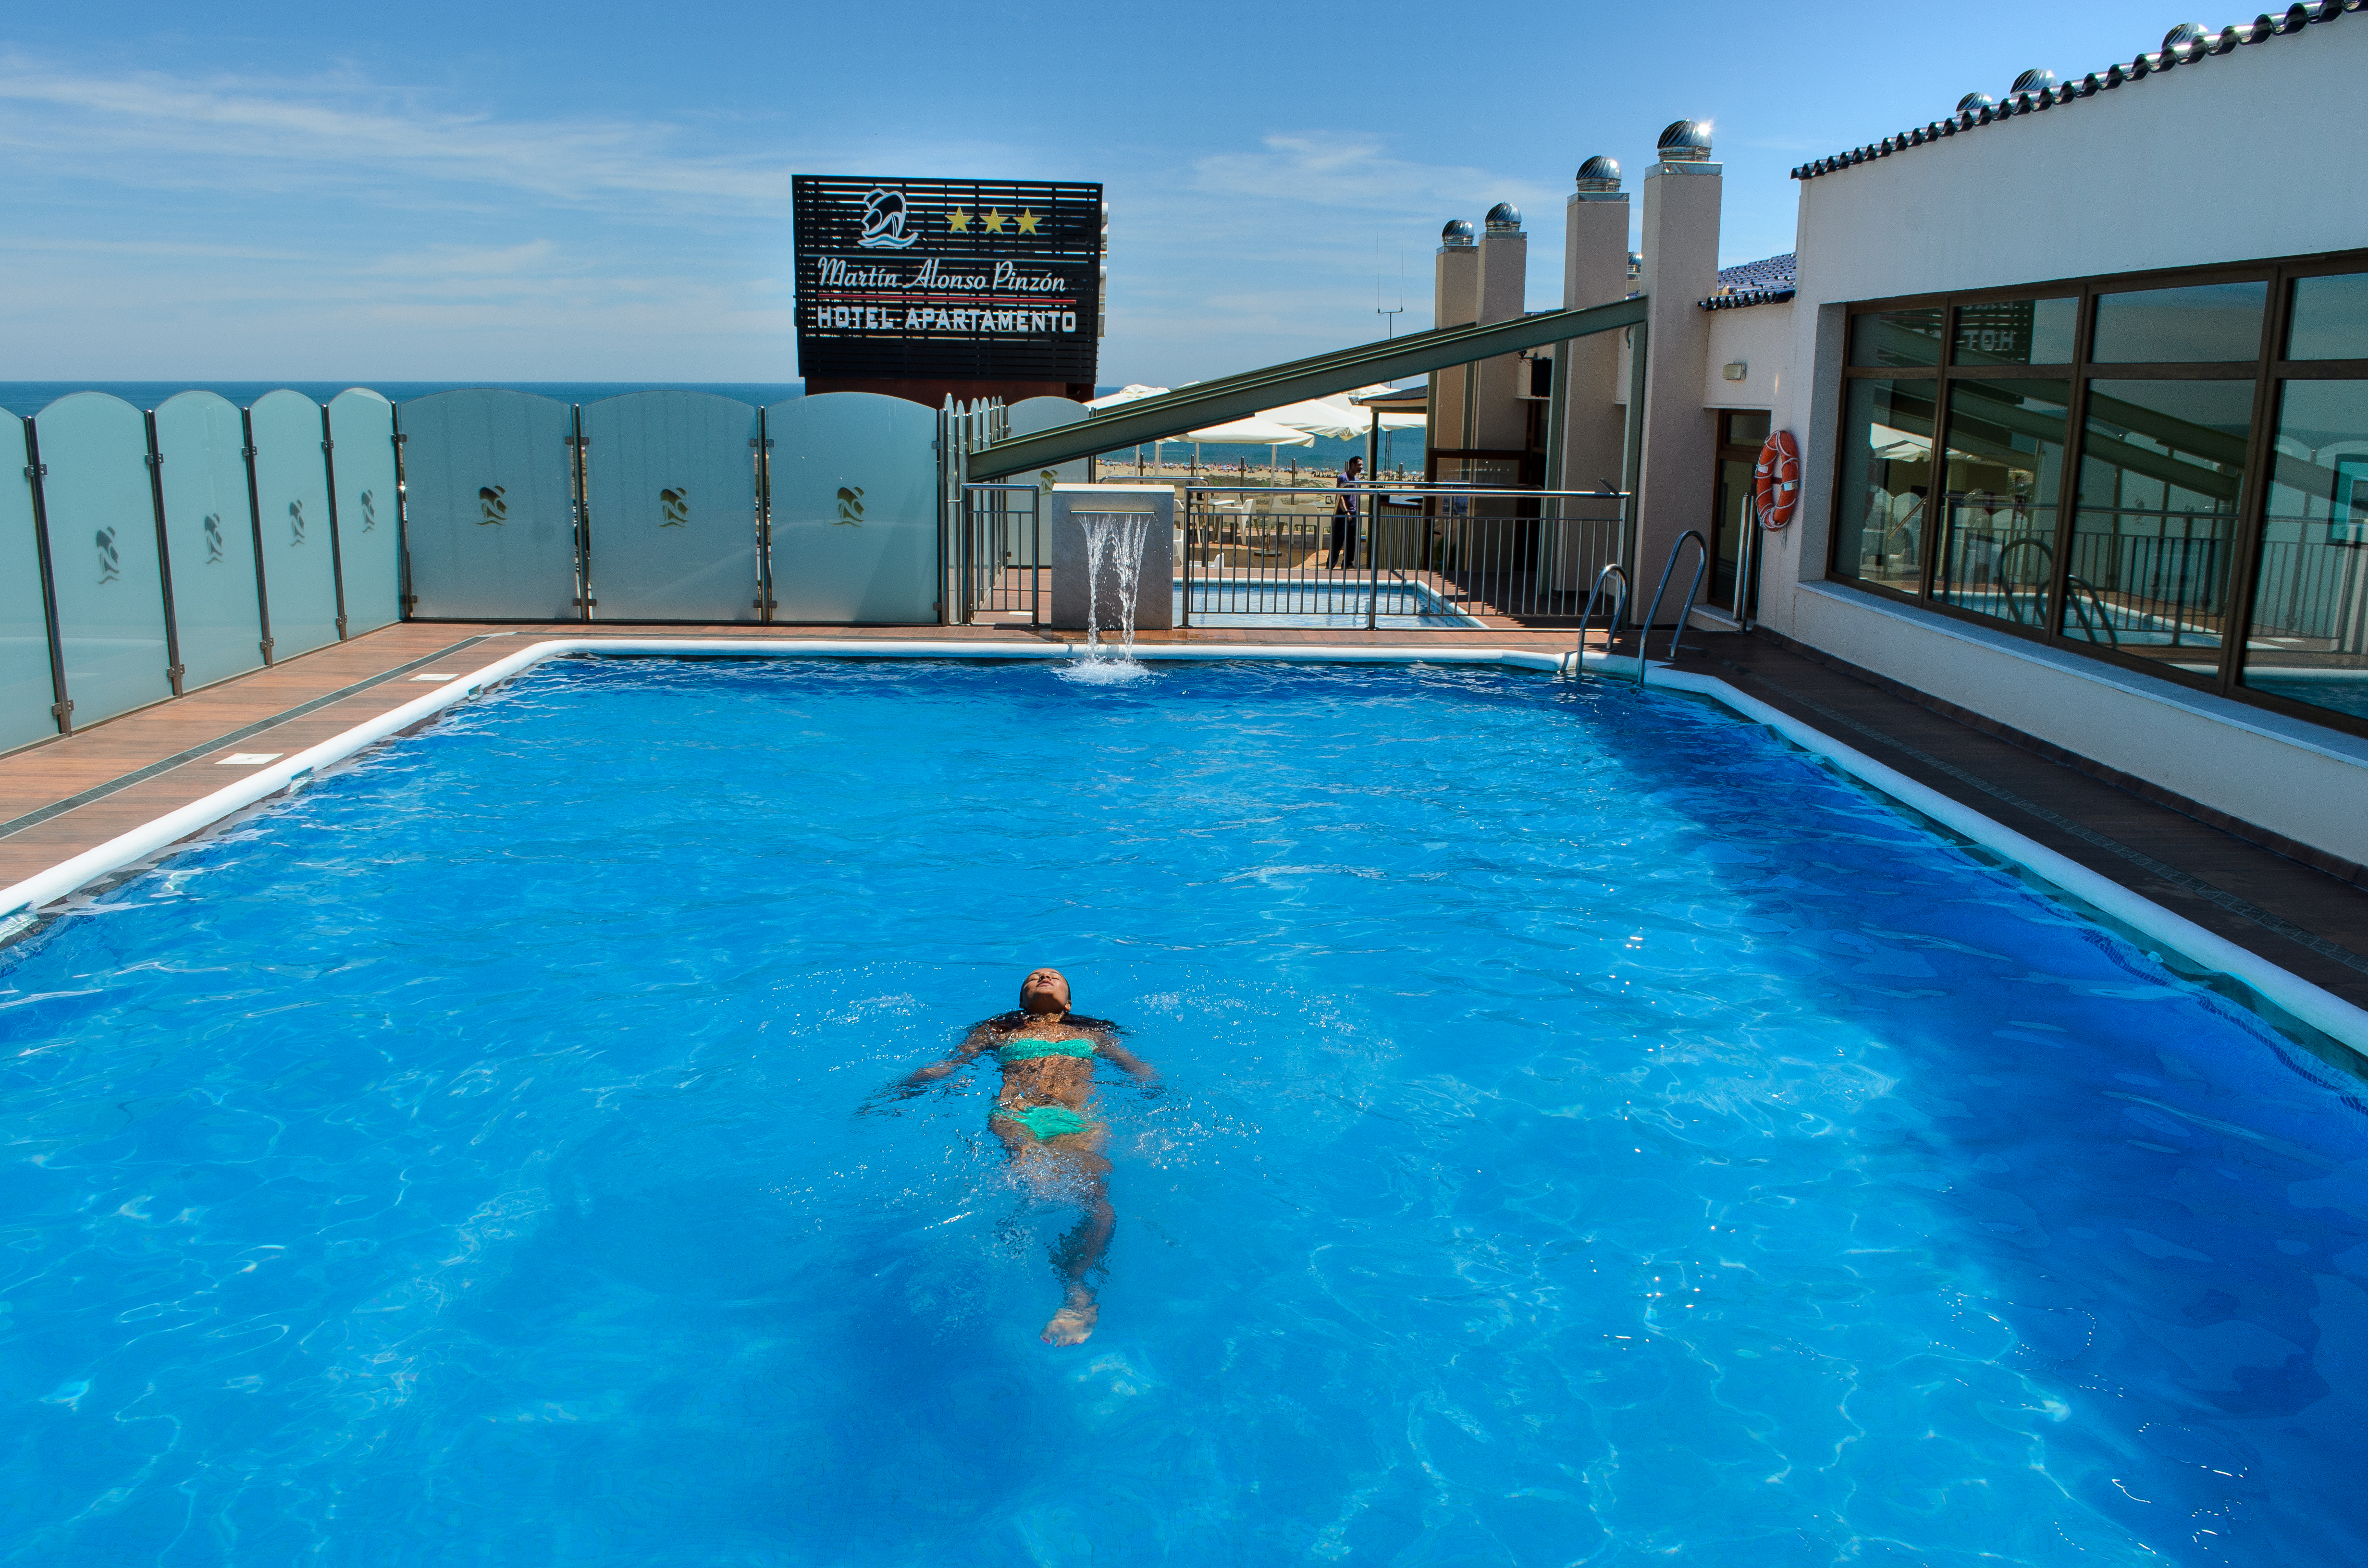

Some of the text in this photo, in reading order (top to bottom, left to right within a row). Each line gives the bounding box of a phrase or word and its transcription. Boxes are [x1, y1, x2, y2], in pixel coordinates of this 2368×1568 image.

[817, 257, 1065, 292] Martín Alonso Pinzón
[818, 306, 1076, 332] HOTEL APARTAMENTO
